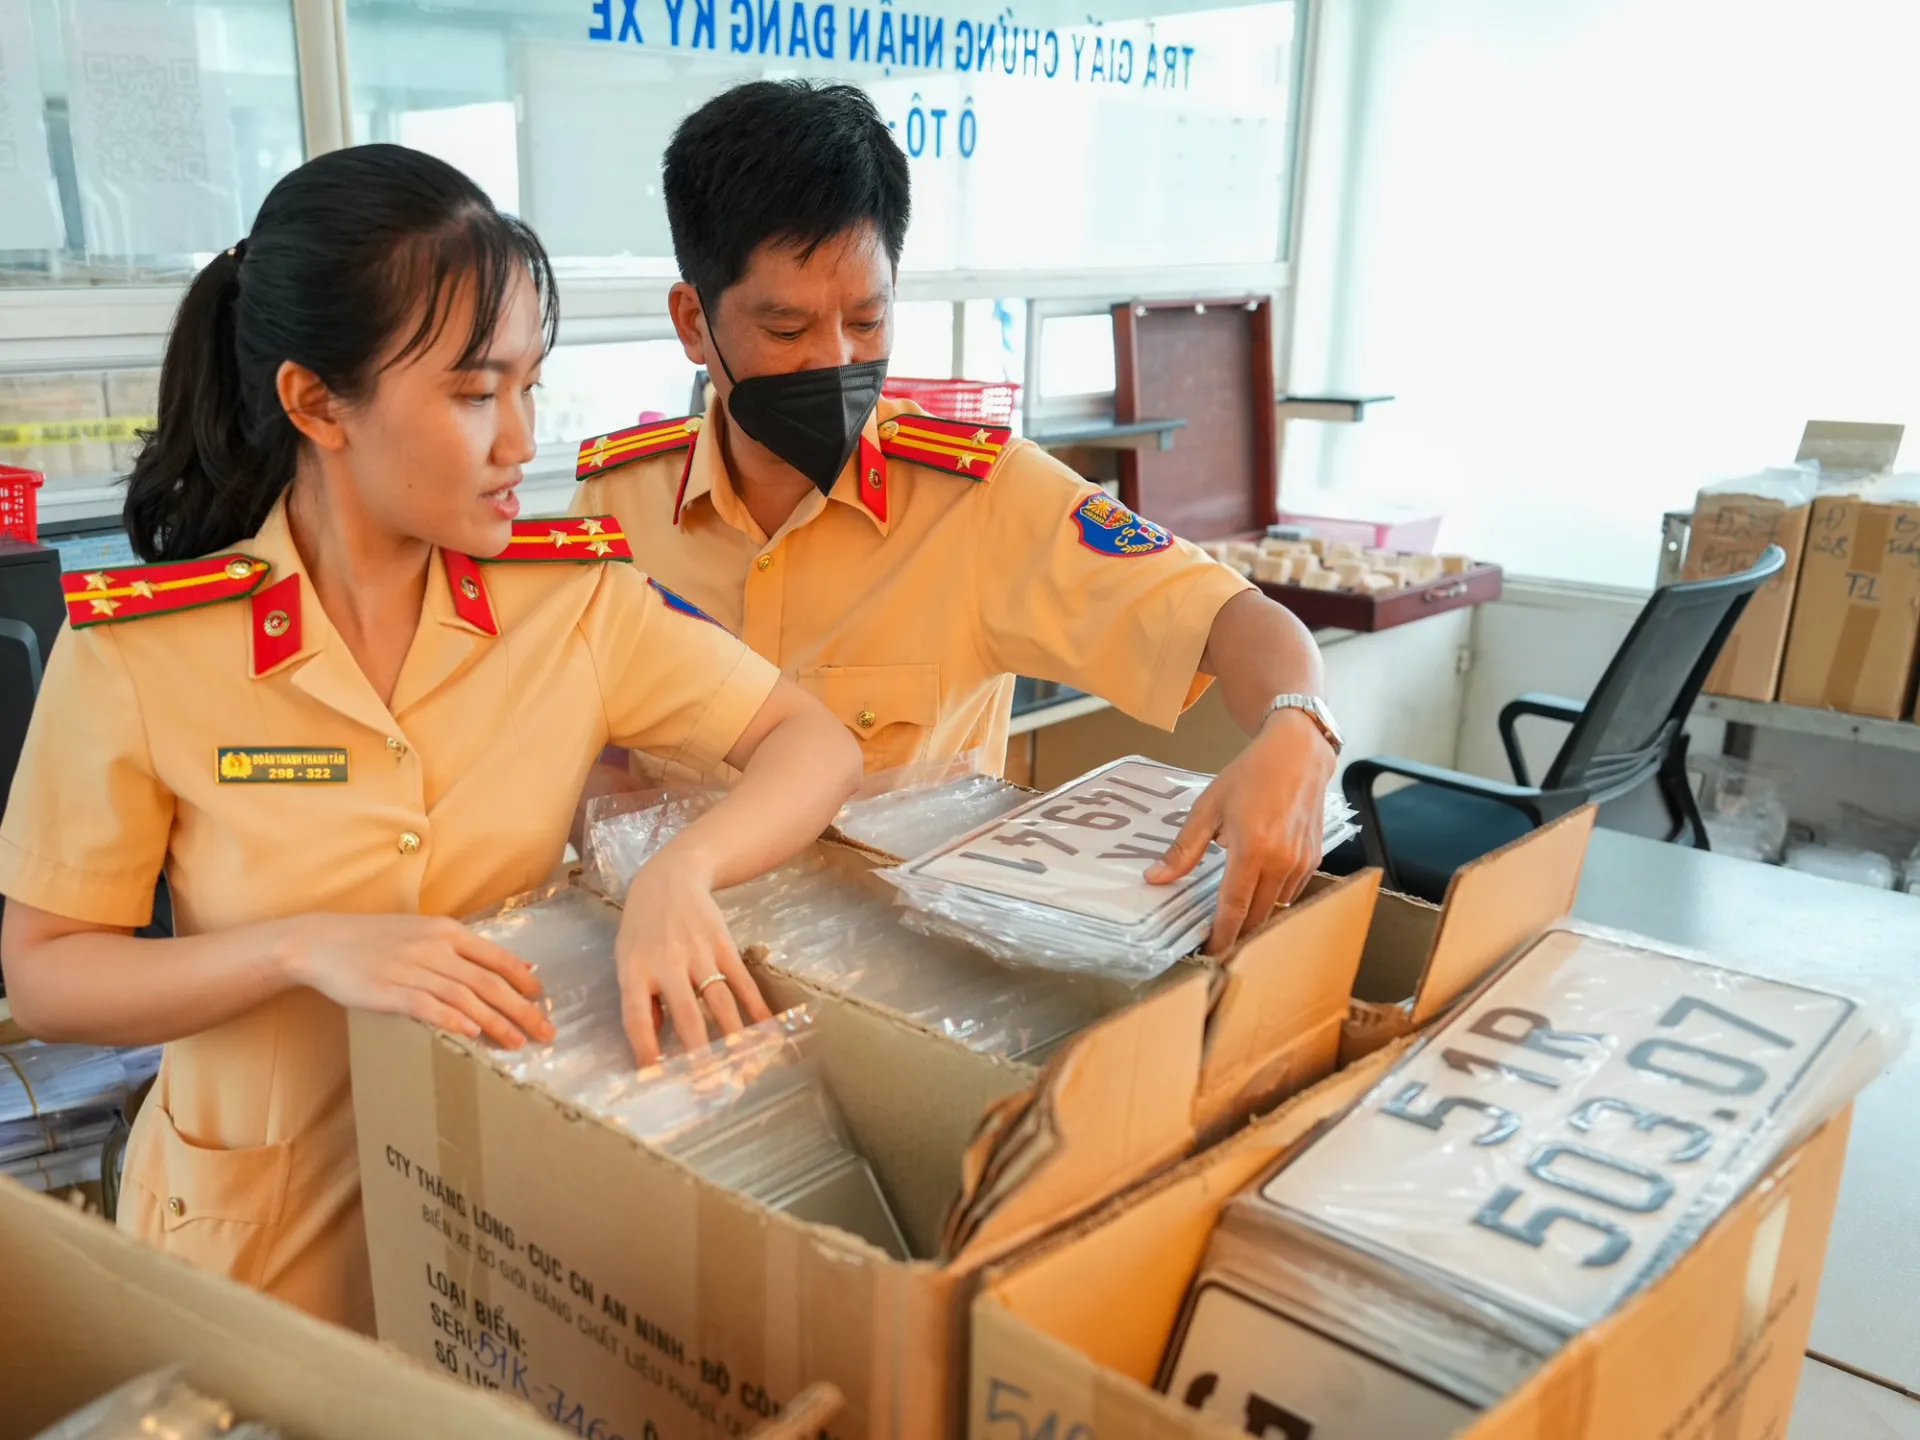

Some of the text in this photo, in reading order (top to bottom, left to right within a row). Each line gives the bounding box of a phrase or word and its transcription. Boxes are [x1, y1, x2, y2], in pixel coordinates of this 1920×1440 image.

[268, 768, 295, 779] 298
[306, 768, 331, 779] 322
[960, 776, 1190, 874] 749.41
[1380, 1006, 1607, 1146] 51R
[1470, 995, 1796, 1269] 503.07
[386, 1144, 411, 1178] CTY
[472, 1203, 515, 1250] LONG
[569, 1270, 594, 1305] CN
[603, 1293, 627, 1327] AN
[635, 1313, 684, 1365] NINH
[456, 1229, 472, 1252] XE
[426, 1263, 467, 1312] LOẠI
[434, 1339, 458, 1375] SỐ
